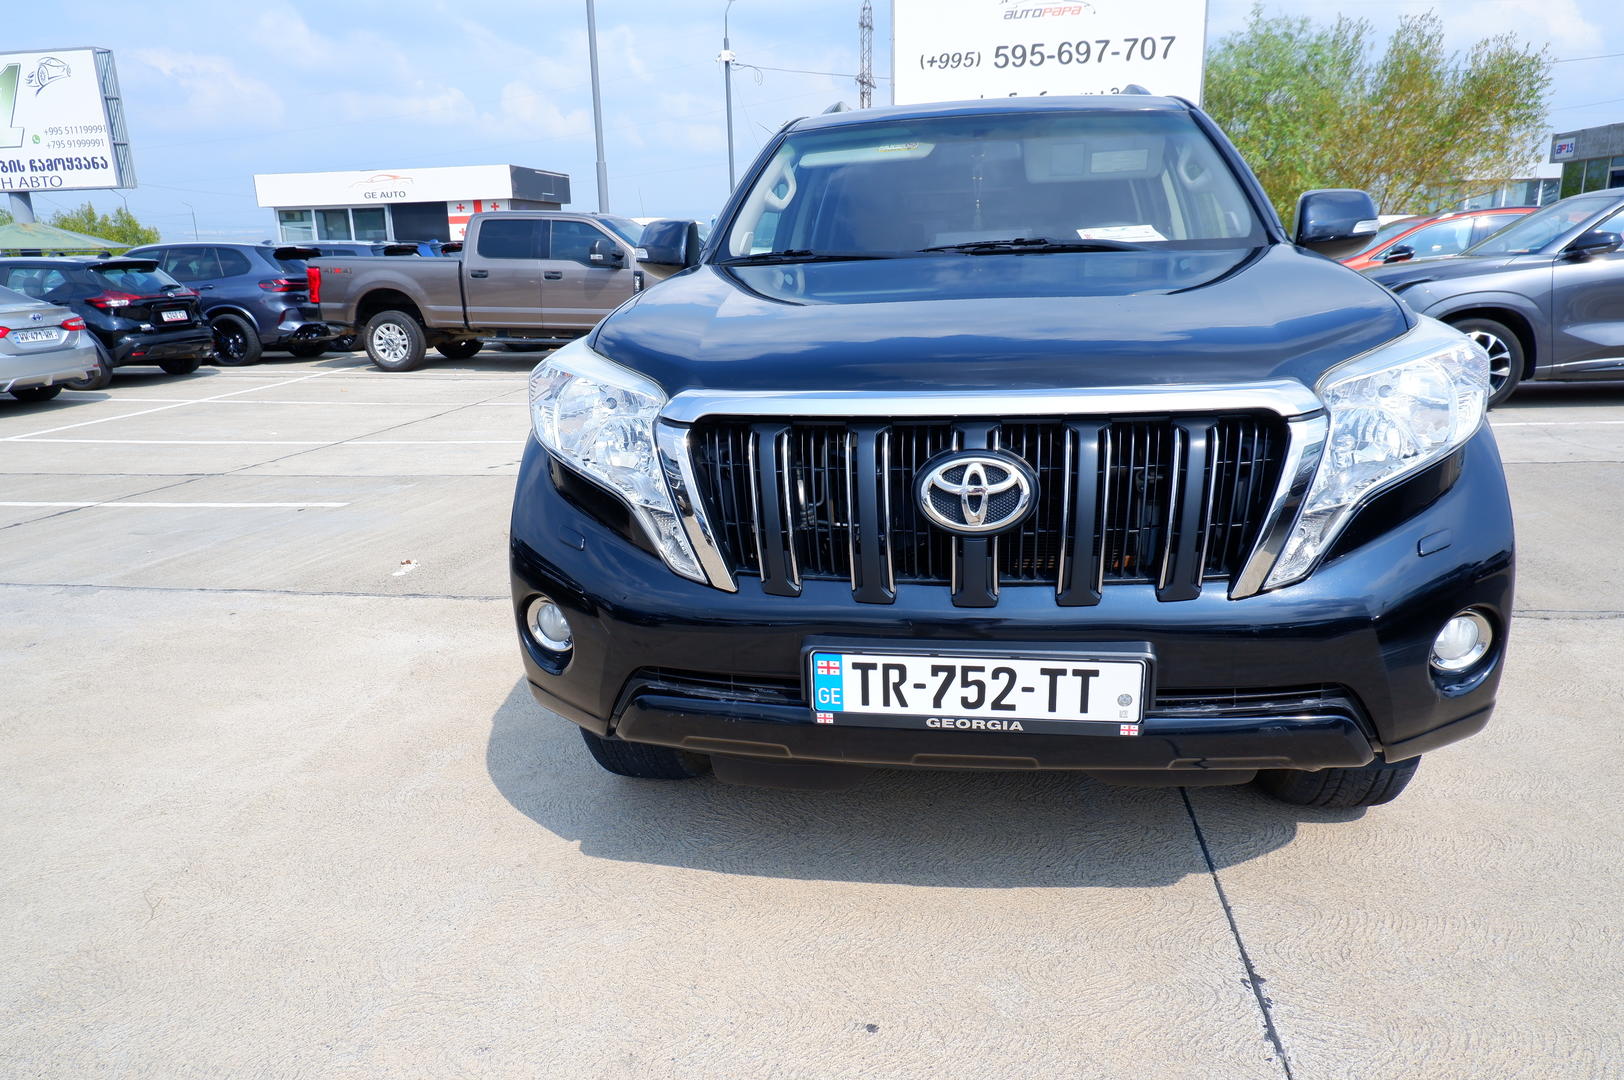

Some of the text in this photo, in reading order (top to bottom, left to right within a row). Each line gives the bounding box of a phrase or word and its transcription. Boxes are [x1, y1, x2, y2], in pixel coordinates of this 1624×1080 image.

[919, 35, 1177, 70] (+995) 595-697-707
[29, 156, 109, 173] ჩამოყვანა
[19, 175, 63, 188] АВТО
[363, 190, 407, 200] GE AUTO
[817, 687, 842, 705] GE
[851, 661, 1100, 714] TR-752-TT
[925, 717, 1025, 732] GEORGIA
